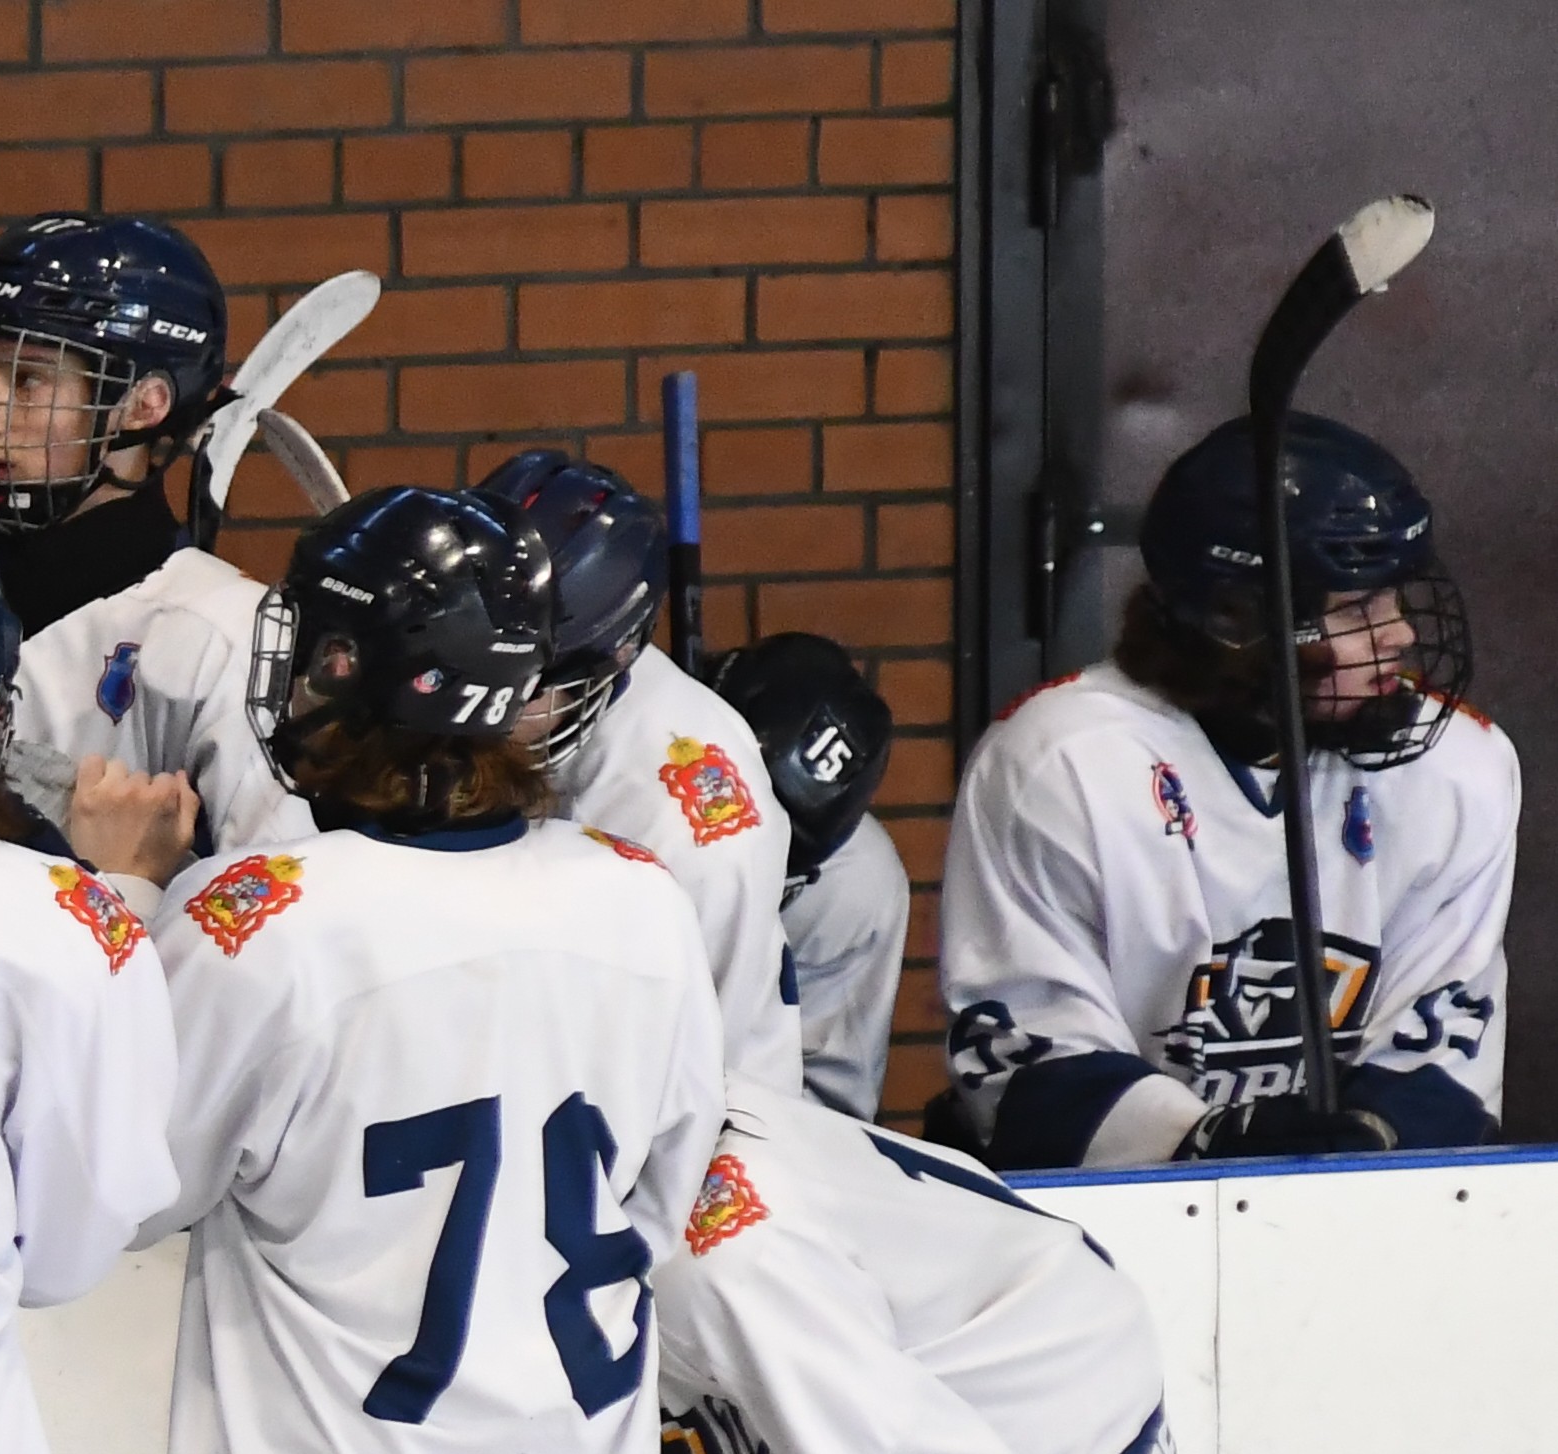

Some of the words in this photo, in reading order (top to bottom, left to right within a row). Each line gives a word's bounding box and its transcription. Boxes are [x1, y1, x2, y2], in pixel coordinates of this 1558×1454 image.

[150, 318, 208, 344] CCM
[320, 576, 375, 605] BAUER
[450, 683, 515, 726] 78
[803, 725, 853, 783] 15
